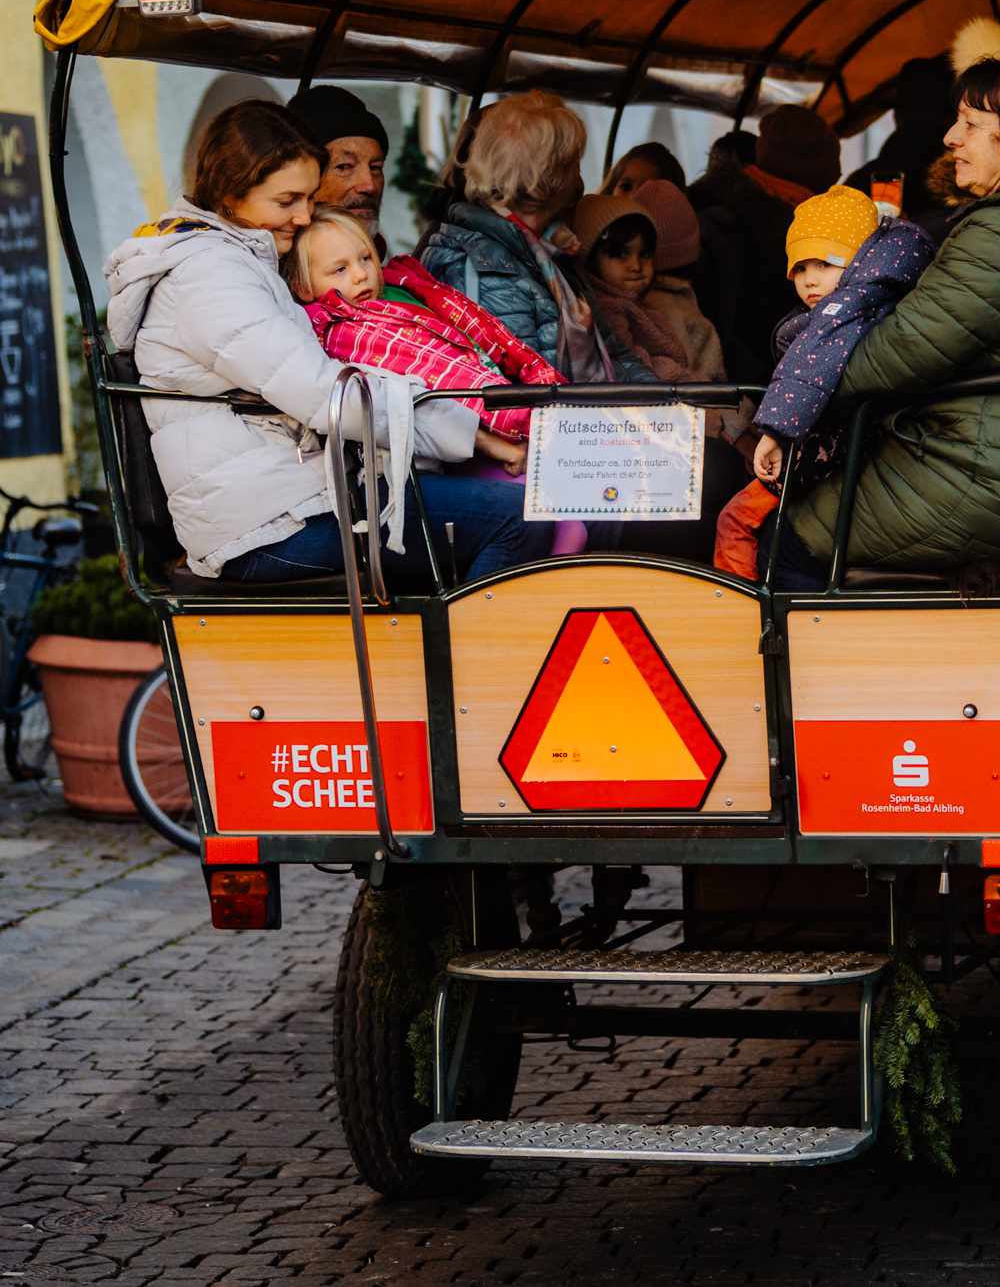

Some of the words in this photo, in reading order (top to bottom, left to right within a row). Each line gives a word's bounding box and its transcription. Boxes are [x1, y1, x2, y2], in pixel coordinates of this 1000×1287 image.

[578, 437, 598, 446] sind
[271, 744, 368, 774] #ECHT
[271, 778, 376, 809] SCHEE
[889, 794, 935, 805] Sparkasse
[861, 803, 931, 814] Rosenheim-Bad
[933, 803, 965, 815] Aibling
